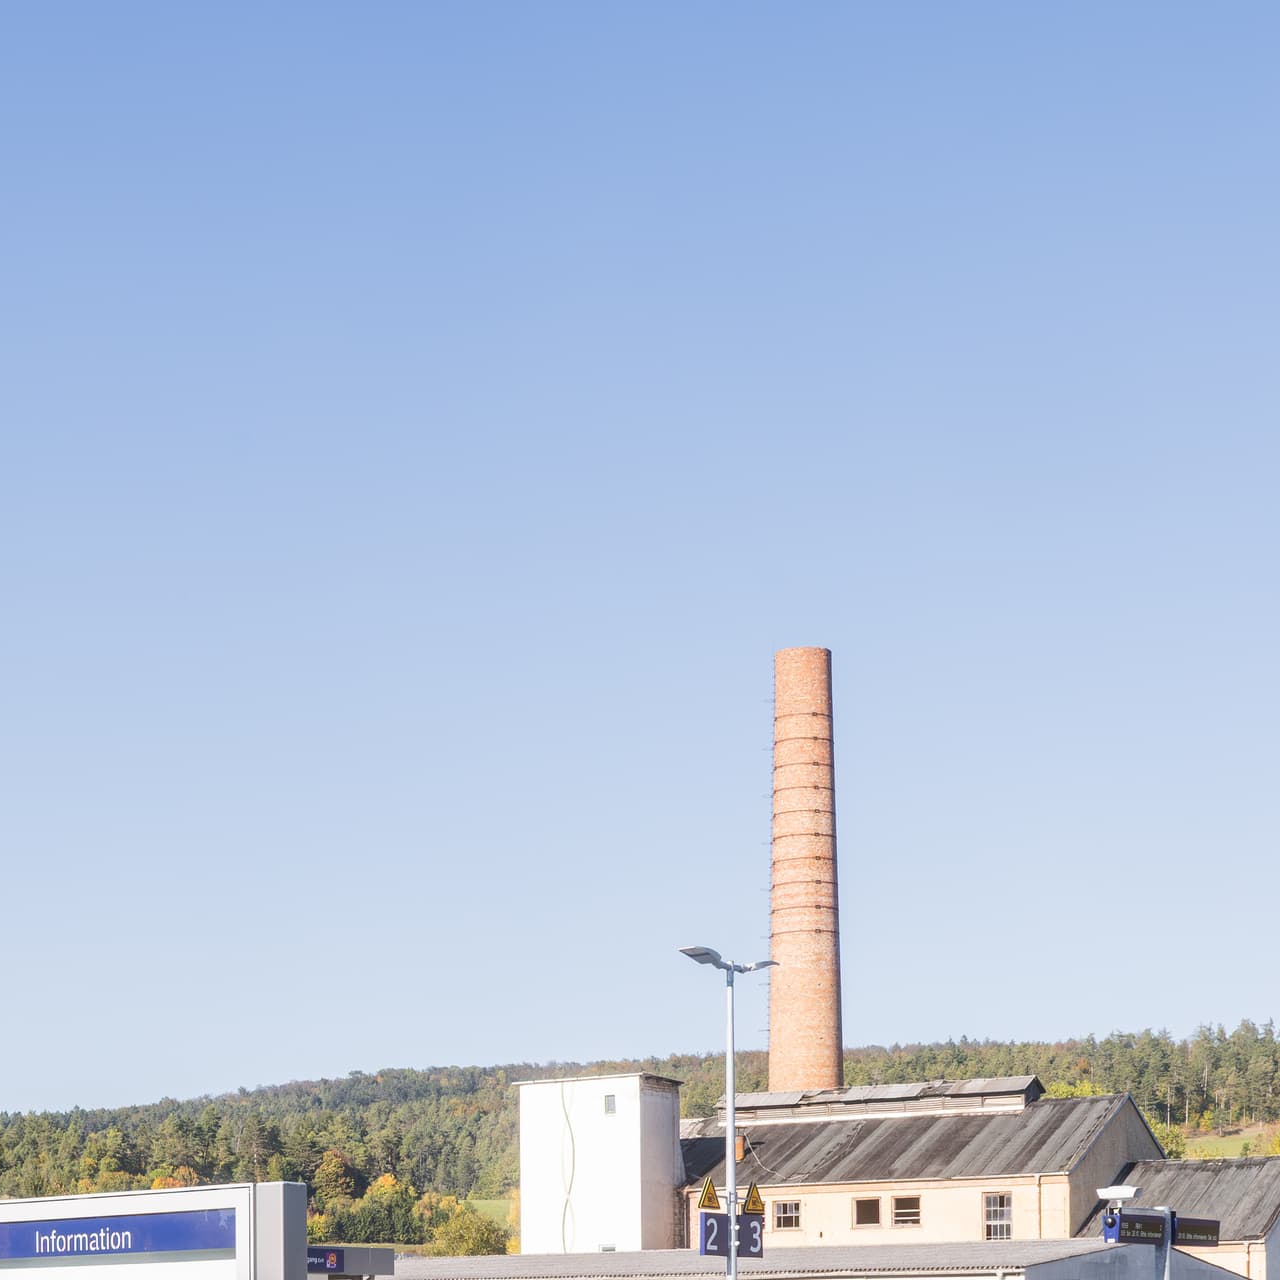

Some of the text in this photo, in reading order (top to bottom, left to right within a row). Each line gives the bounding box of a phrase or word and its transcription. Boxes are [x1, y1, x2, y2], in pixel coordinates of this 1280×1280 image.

[35, 1227, 132, 1254] Information
[706, 1218, 718, 1250] 2
[750, 1221, 761, 1253] 3
